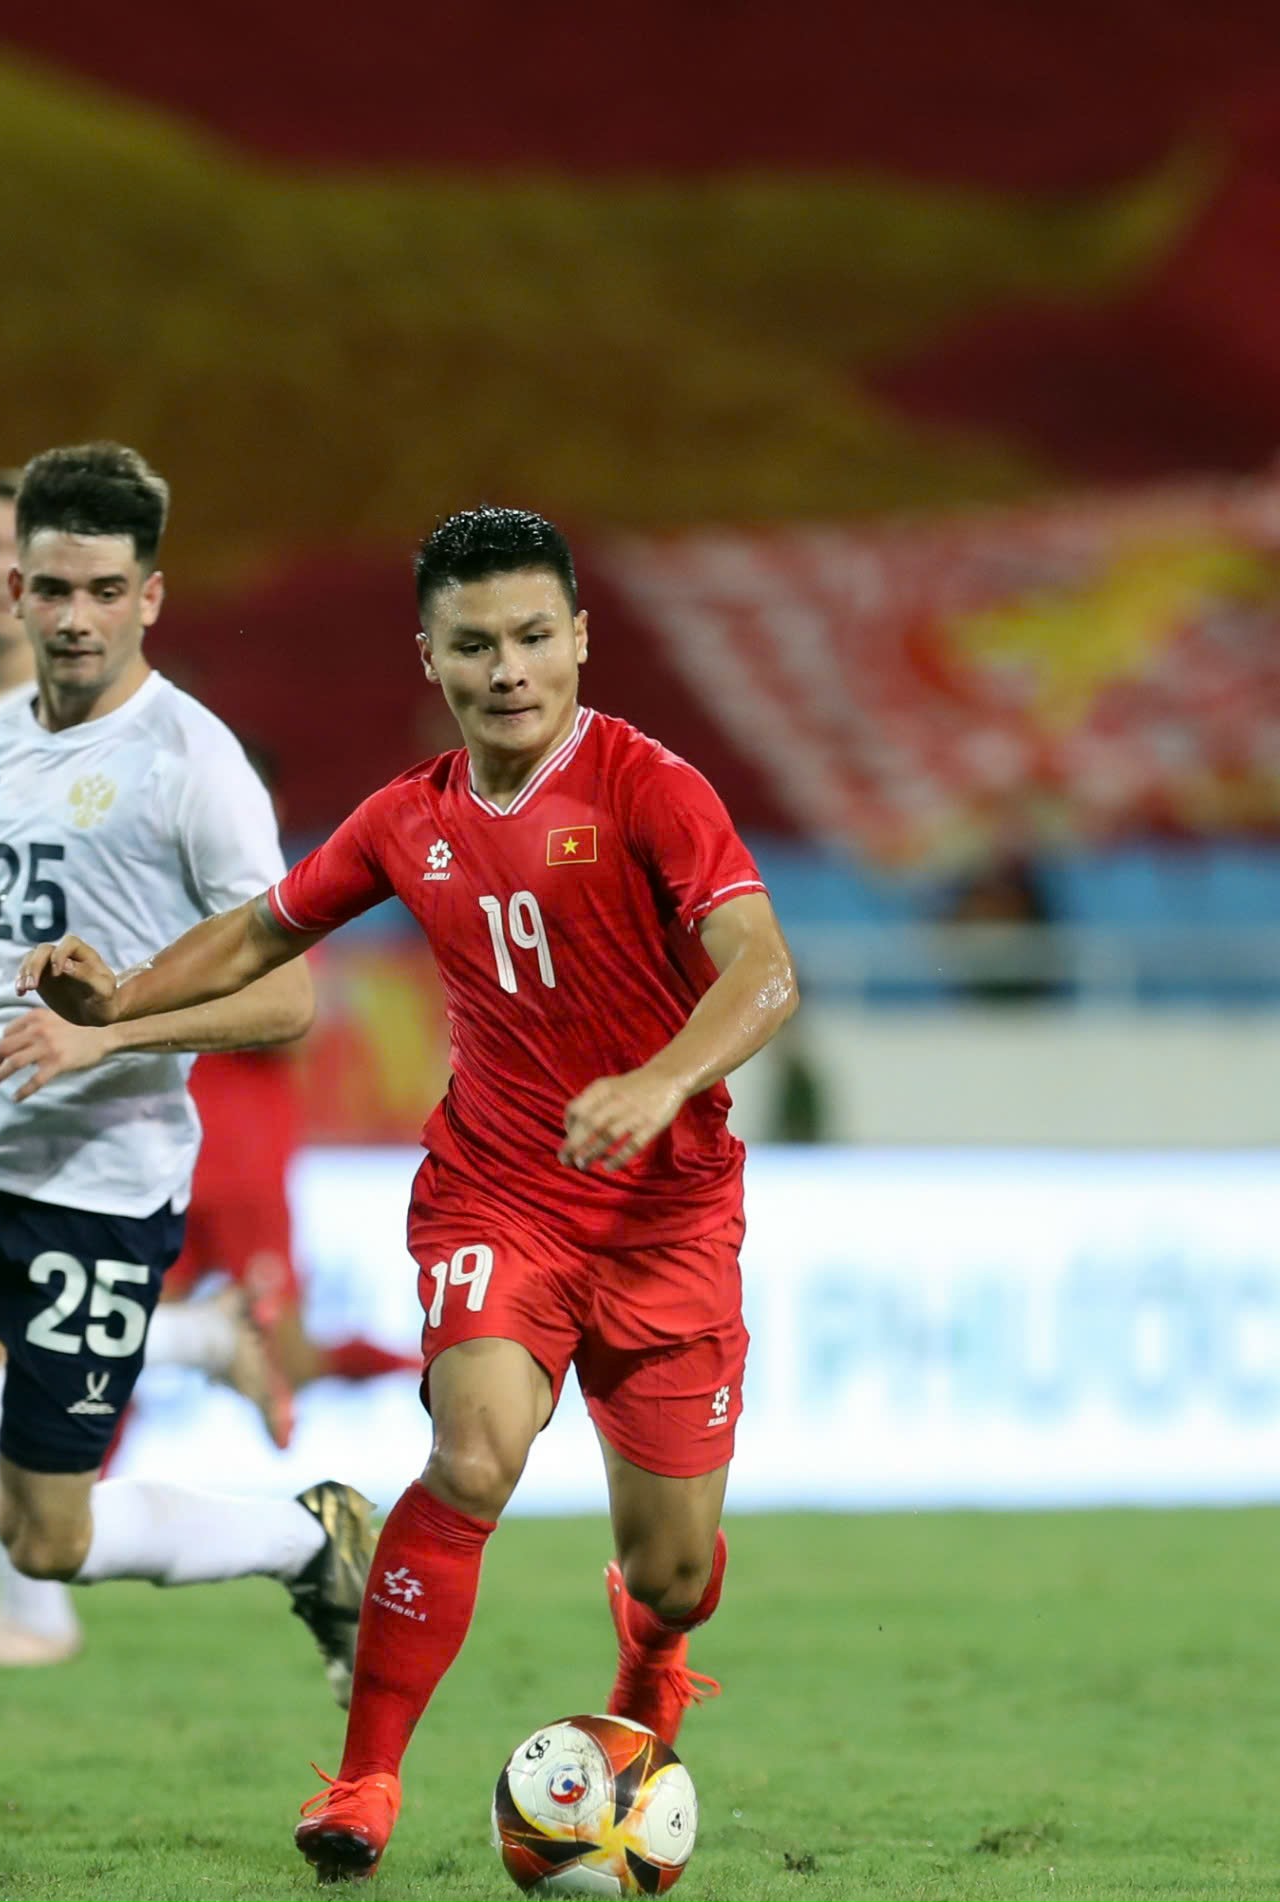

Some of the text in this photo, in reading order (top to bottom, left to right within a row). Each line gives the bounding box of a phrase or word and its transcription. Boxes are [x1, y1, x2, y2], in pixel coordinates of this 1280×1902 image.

[478, 890, 557, 994] 19
[25, 1250, 150, 1358] 25
[429, 1244, 494, 1328] 19
